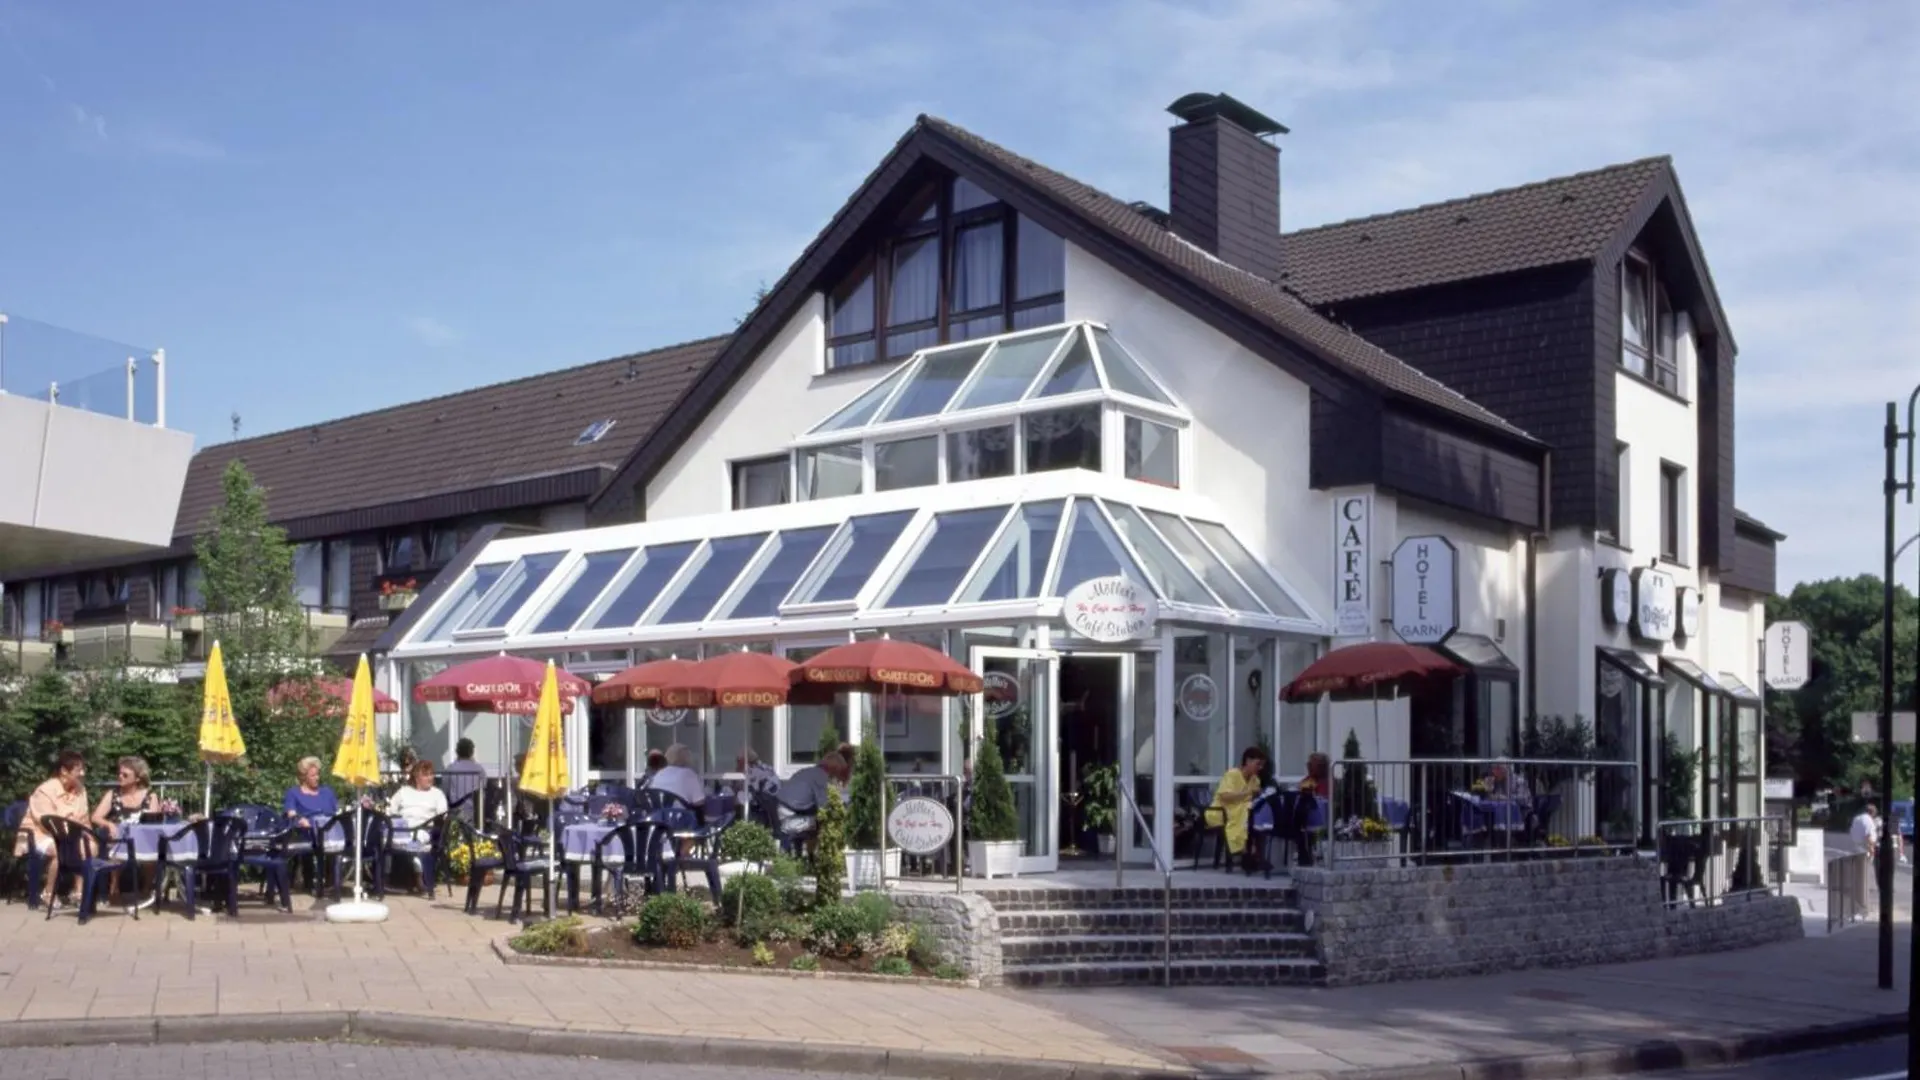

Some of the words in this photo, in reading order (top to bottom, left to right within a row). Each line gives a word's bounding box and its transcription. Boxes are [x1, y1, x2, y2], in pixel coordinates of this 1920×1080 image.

[1342, 499, 1362, 602] CAFÉ
[1416, 543, 1430, 620] HOTEL
[1076, 612, 1103, 637] Café
[1400, 625, 1443, 637] GARNI
[1781, 626, 1791, 675] HOTEL
[876, 668, 908, 681] CARTE
[1772, 675, 1802, 685] GARNI
[722, 692, 752, 704] CARTE
